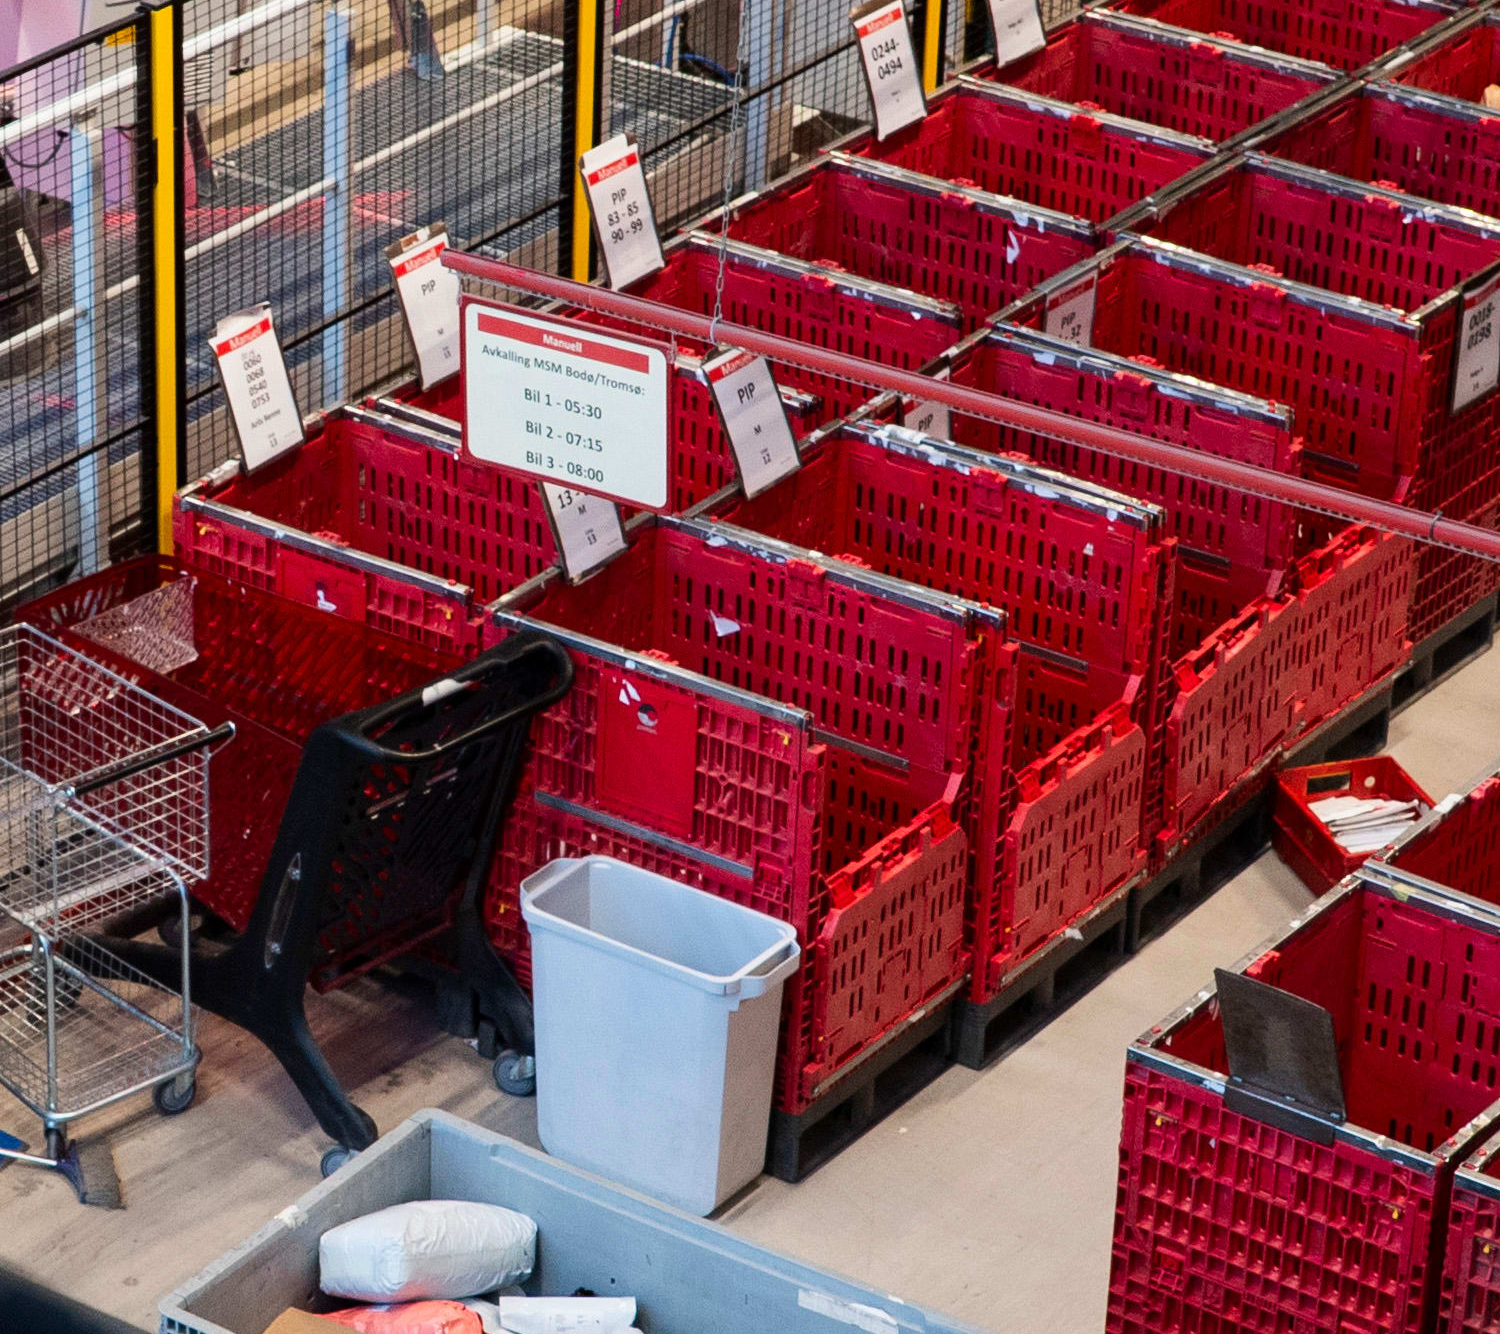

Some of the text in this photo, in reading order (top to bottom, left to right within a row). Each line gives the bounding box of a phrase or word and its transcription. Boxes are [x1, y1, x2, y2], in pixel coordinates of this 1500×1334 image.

[871, 38, 900, 61] 0244-
[878, 56, 903, 80] 0494
[611, 188, 627, 205] PIP
[607, 211, 620, 226] 83
[626, 201, 639, 216] 85
[611, 229, 624, 244] 90
[630, 218, 643, 234] 99
[420, 279, 437, 296] PIP
[541, 333, 583, 353] Manuell
[481, 344, 646, 396] Avkalling MSM Bodø/Tromsø:
[251, 393, 271, 409] 0753
[524, 387, 541, 403] Bil
[545, 394, 552, 406] 1
[564, 399, 602, 420] 05:30
[737, 382, 756, 404] PIP
[753, 425, 762, 435] M
[918, 414, 934, 431] PIP
[525, 420, 542, 436] Bil
[546, 426, 553, 440] 2
[565, 431, 603, 452] 07:15
[526, 450, 542, 466] Bil
[546, 457, 554, 469] 3
[567, 462, 604, 483] 08:00
[557, 490, 573, 509] 13
[578, 505, 587, 515] M
